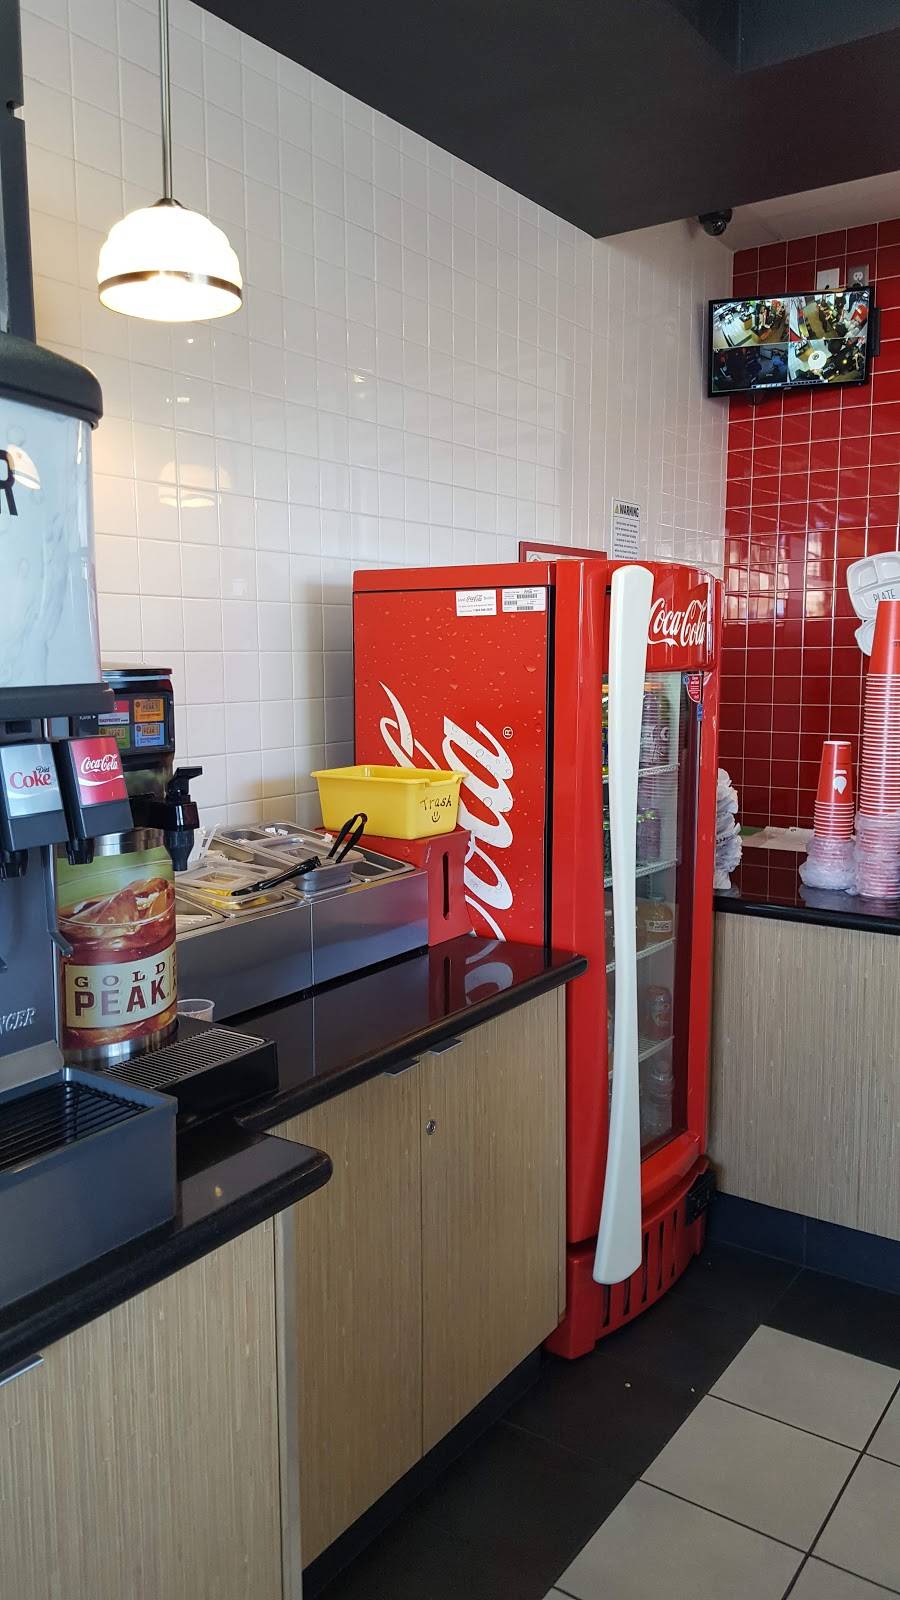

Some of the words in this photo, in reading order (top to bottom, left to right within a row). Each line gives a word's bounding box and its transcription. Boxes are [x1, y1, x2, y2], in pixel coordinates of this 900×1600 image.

[620, 504, 639, 517] WARNING
[873, 589, 896, 602] PLATE
[648, 598, 707, 647] Coca-Cola
[81, 754, 119, 774] Coca-Cola
[10, 770, 52, 789] Coke
[419, 795, 452, 810] Trash
[74, 961, 166, 988] GOLD
[74, 976, 167, 1017] PEAK
